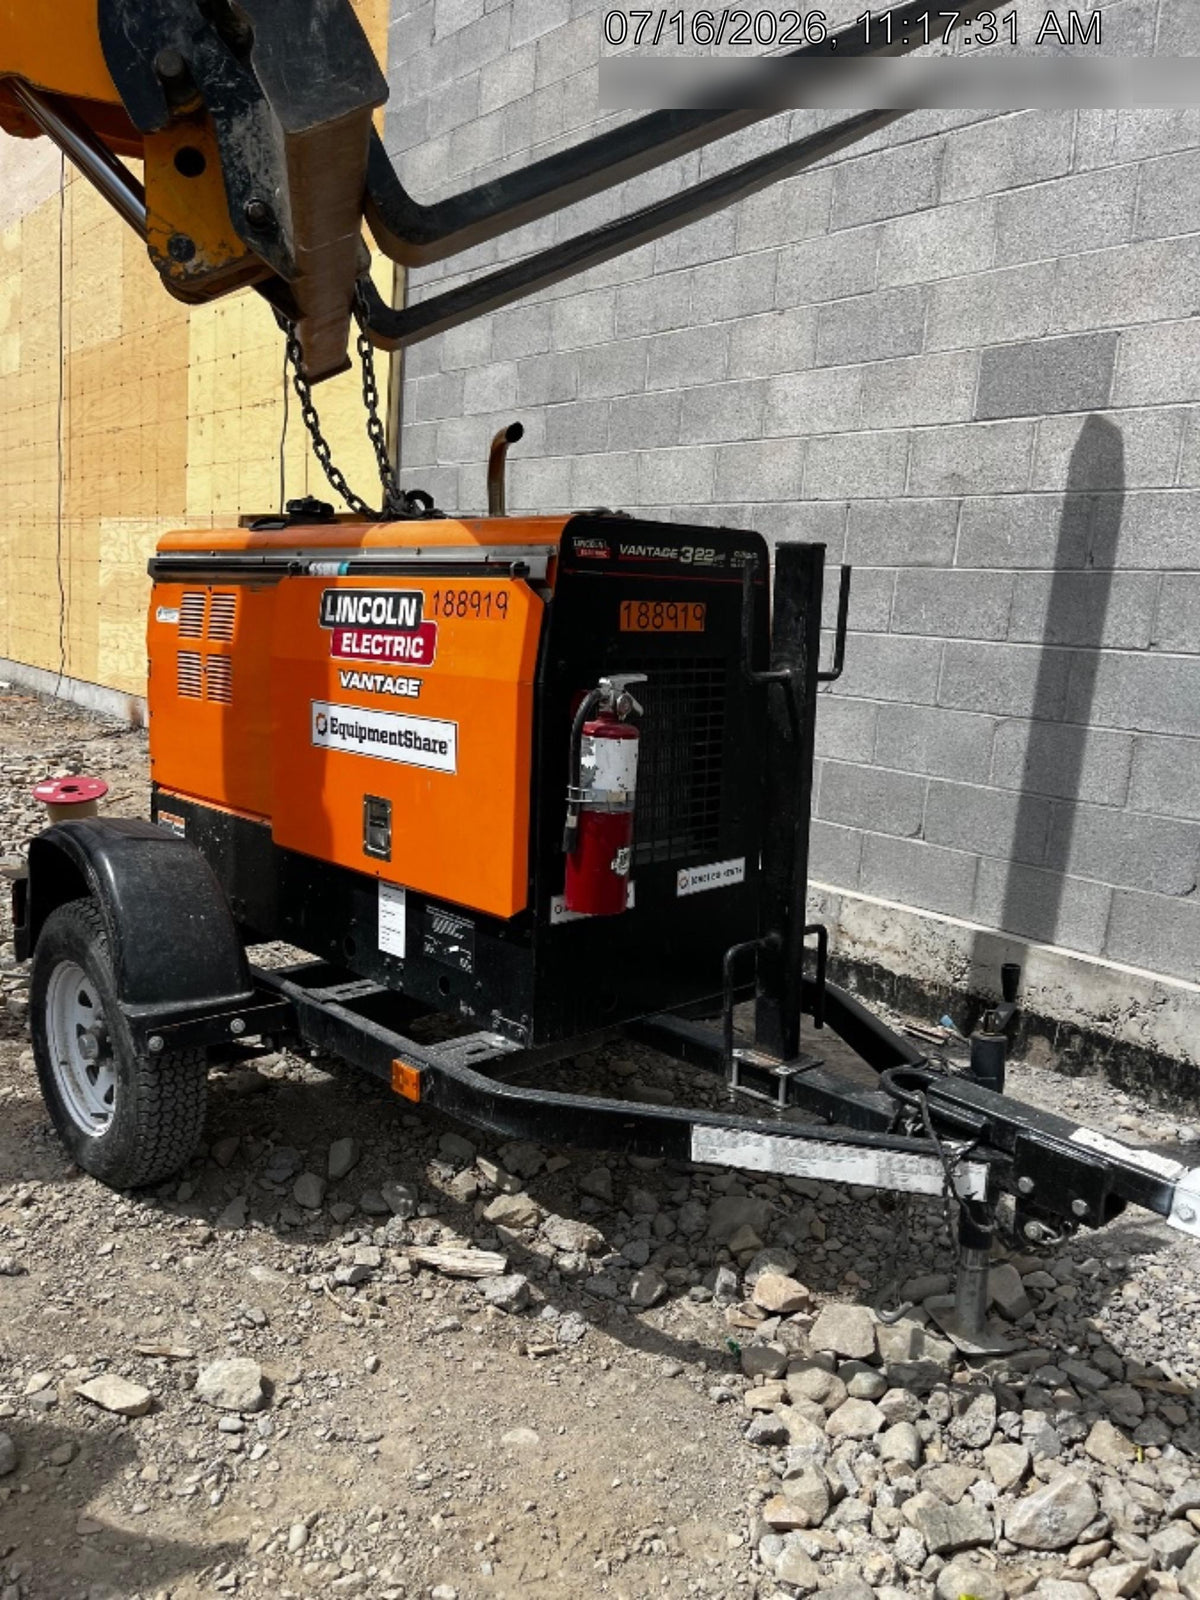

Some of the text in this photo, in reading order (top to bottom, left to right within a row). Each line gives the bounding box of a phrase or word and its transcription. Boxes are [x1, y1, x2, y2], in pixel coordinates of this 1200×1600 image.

[619, 543, 679, 559] VANTAGE
[679, 546, 716, 563] 322
[325, 595, 416, 627] LINCOLN
[433, 590, 508, 619] 188919
[623, 602, 704, 629] 188919
[341, 632, 424, 658] ELECTRIC
[339, 670, 421, 697] VANTAGE
[330, 717, 447, 755] EquipmentShare
